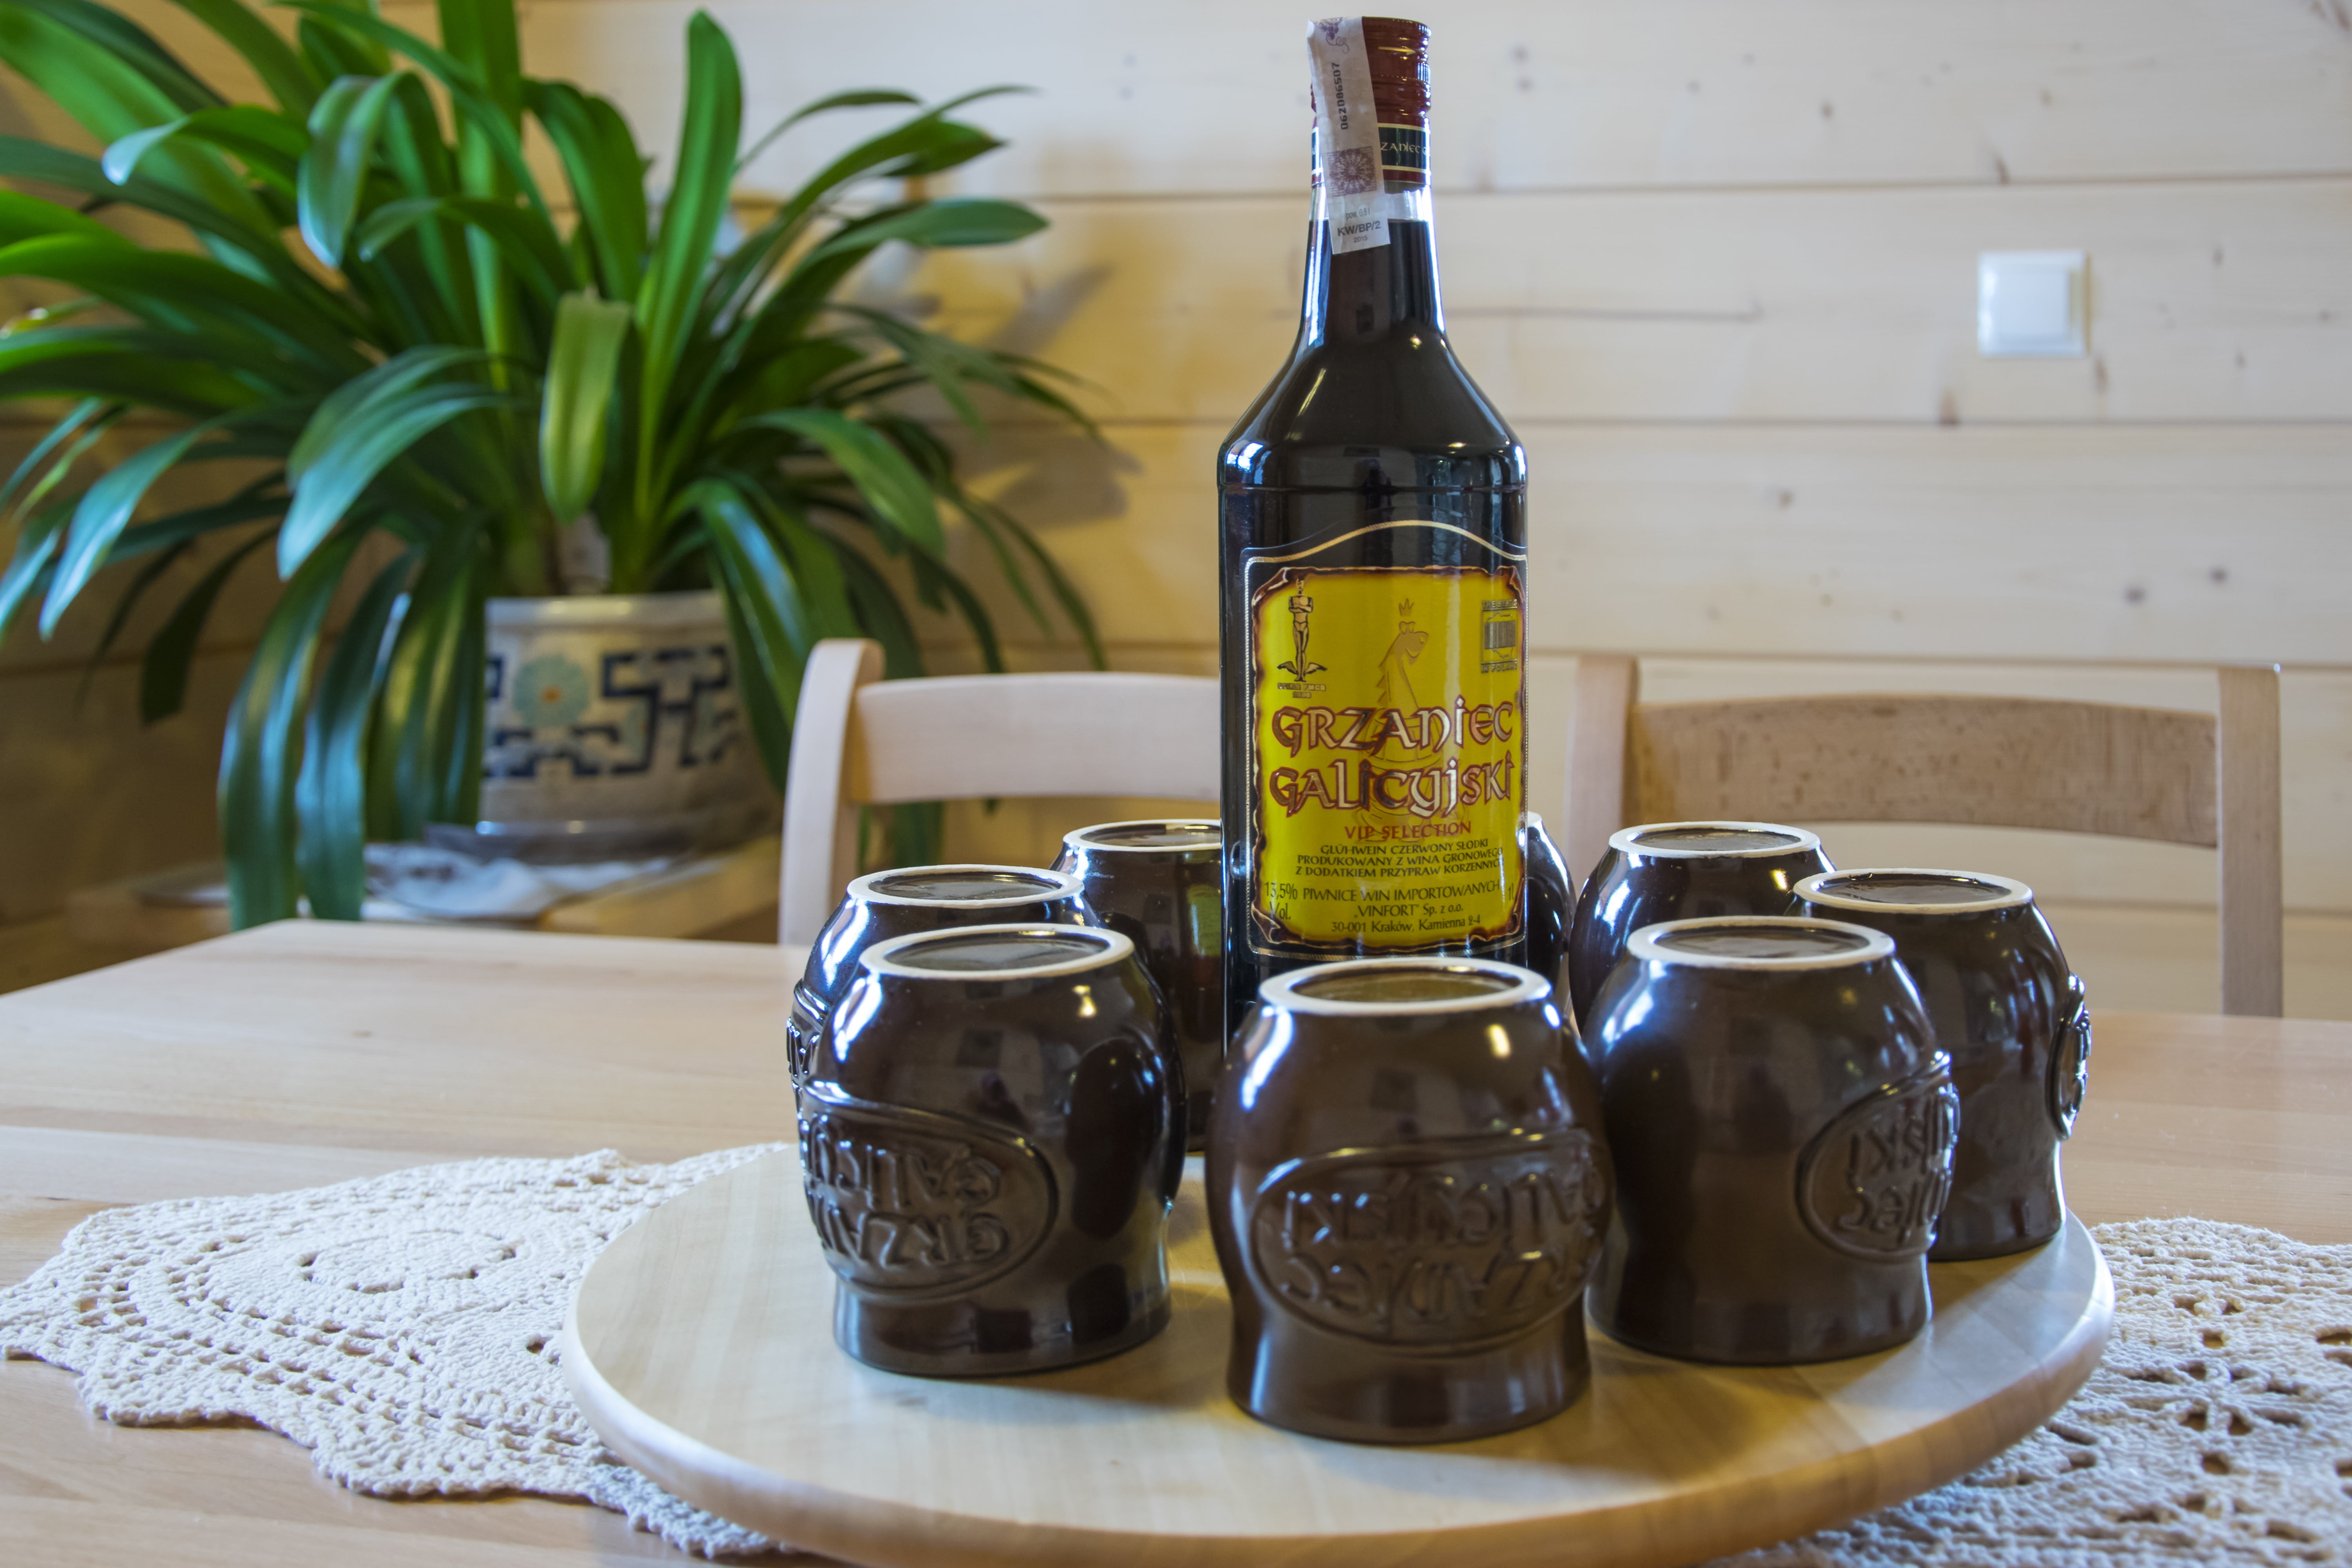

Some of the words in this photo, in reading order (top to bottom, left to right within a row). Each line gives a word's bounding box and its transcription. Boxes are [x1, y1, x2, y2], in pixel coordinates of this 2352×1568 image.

[1331, 62, 1348, 130] 062086507
[1380, 142, 1421, 154] ZANIEC
[1337, 220, 1381, 236] KW/BP/2
[1344, 826, 1374, 840] VIP
[1381, 820, 1472, 842] SELECTION
[1320, 843, 1387, 855] GLÜHWEIN
[1390, 842, 1454, 854] CZERWONY
[1456, 838, 1488, 851] SŁODKI
[1298, 855, 1392, 866] PRODUKOWANY
[1396, 857, 1403, 865] Z
[1407, 855, 1439, 865] WINA
[1443, 847, 1503, 863] GRONOWEGO
[1295, 866, 1302, 875] Z
[1305, 867, 1376, 877] DODATKIEM
[1380, 867, 1441, 877] PRZYPRAW
[1264, 882, 1298, 900] 13,5%
[1303, 887, 1357, 901] PIWNICE
[1360, 889, 1390, 901] WIN
[1394, 879, 1500, 901] IMPORTOWANYCH
[1269, 901, 1291, 920] Vol.
[1423, 903, 1437, 917] Sp.
[1448, 904, 1463, 913] o.o.
[1331, 922, 1366, 932] 30-001
[1371, 920, 1414, 933] Kraków,
[1418, 918, 1466, 931] Kamienna
